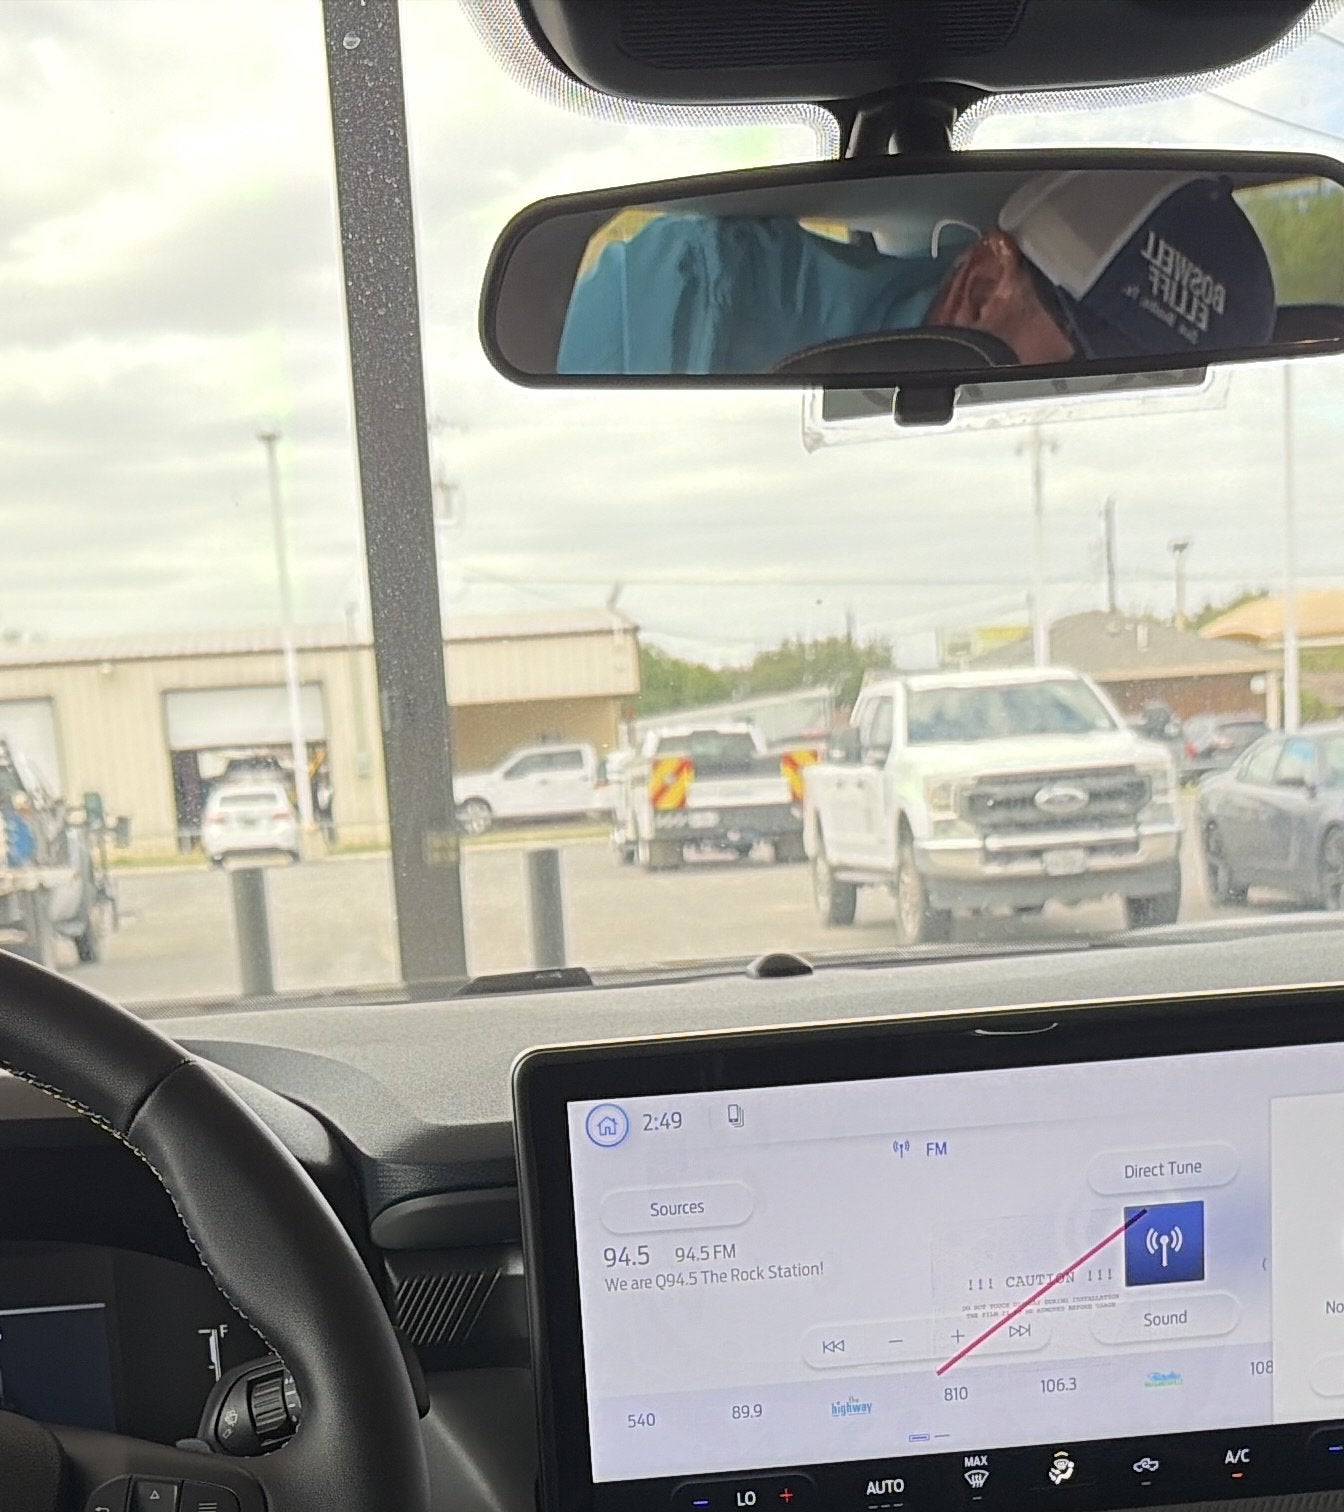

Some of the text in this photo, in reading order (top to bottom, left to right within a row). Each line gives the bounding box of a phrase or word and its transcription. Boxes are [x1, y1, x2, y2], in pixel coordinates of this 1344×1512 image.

[642, 1111, 683, 1132] 2:49
[926, 1141, 948, 1157] FM
[1124, 1160, 1202, 1179] Direct Tune
[650, 1200, 705, 1218] Sources
[603, 1245, 650, 1267] 94.5
[675, 1243, 737, 1263] 94.5 FM
[605, 1261, 824, 1293] We are Q94.5 The Rock Station!
[1006, 1272, 1075, 1288] CAUTION
[1326, 1300, 1344, 1315] No
[1144, 1310, 1188, 1327] Sound
[219, 1324, 229, 1338] F
[1040, 1377, 1077, 1394] 106.3
[943, 1386, 968, 1402] 810
[731, 1404, 763, 1420] 89.9
[831, 1401, 872, 1417] highway
[627, 1412, 656, 1428] 540
[964, 1455, 988, 1468] MAX
[1224, 1448, 1251, 1464] A/C
[866, 1478, 904, 1496] AUTO
[736, 1491, 756, 1507] LO
